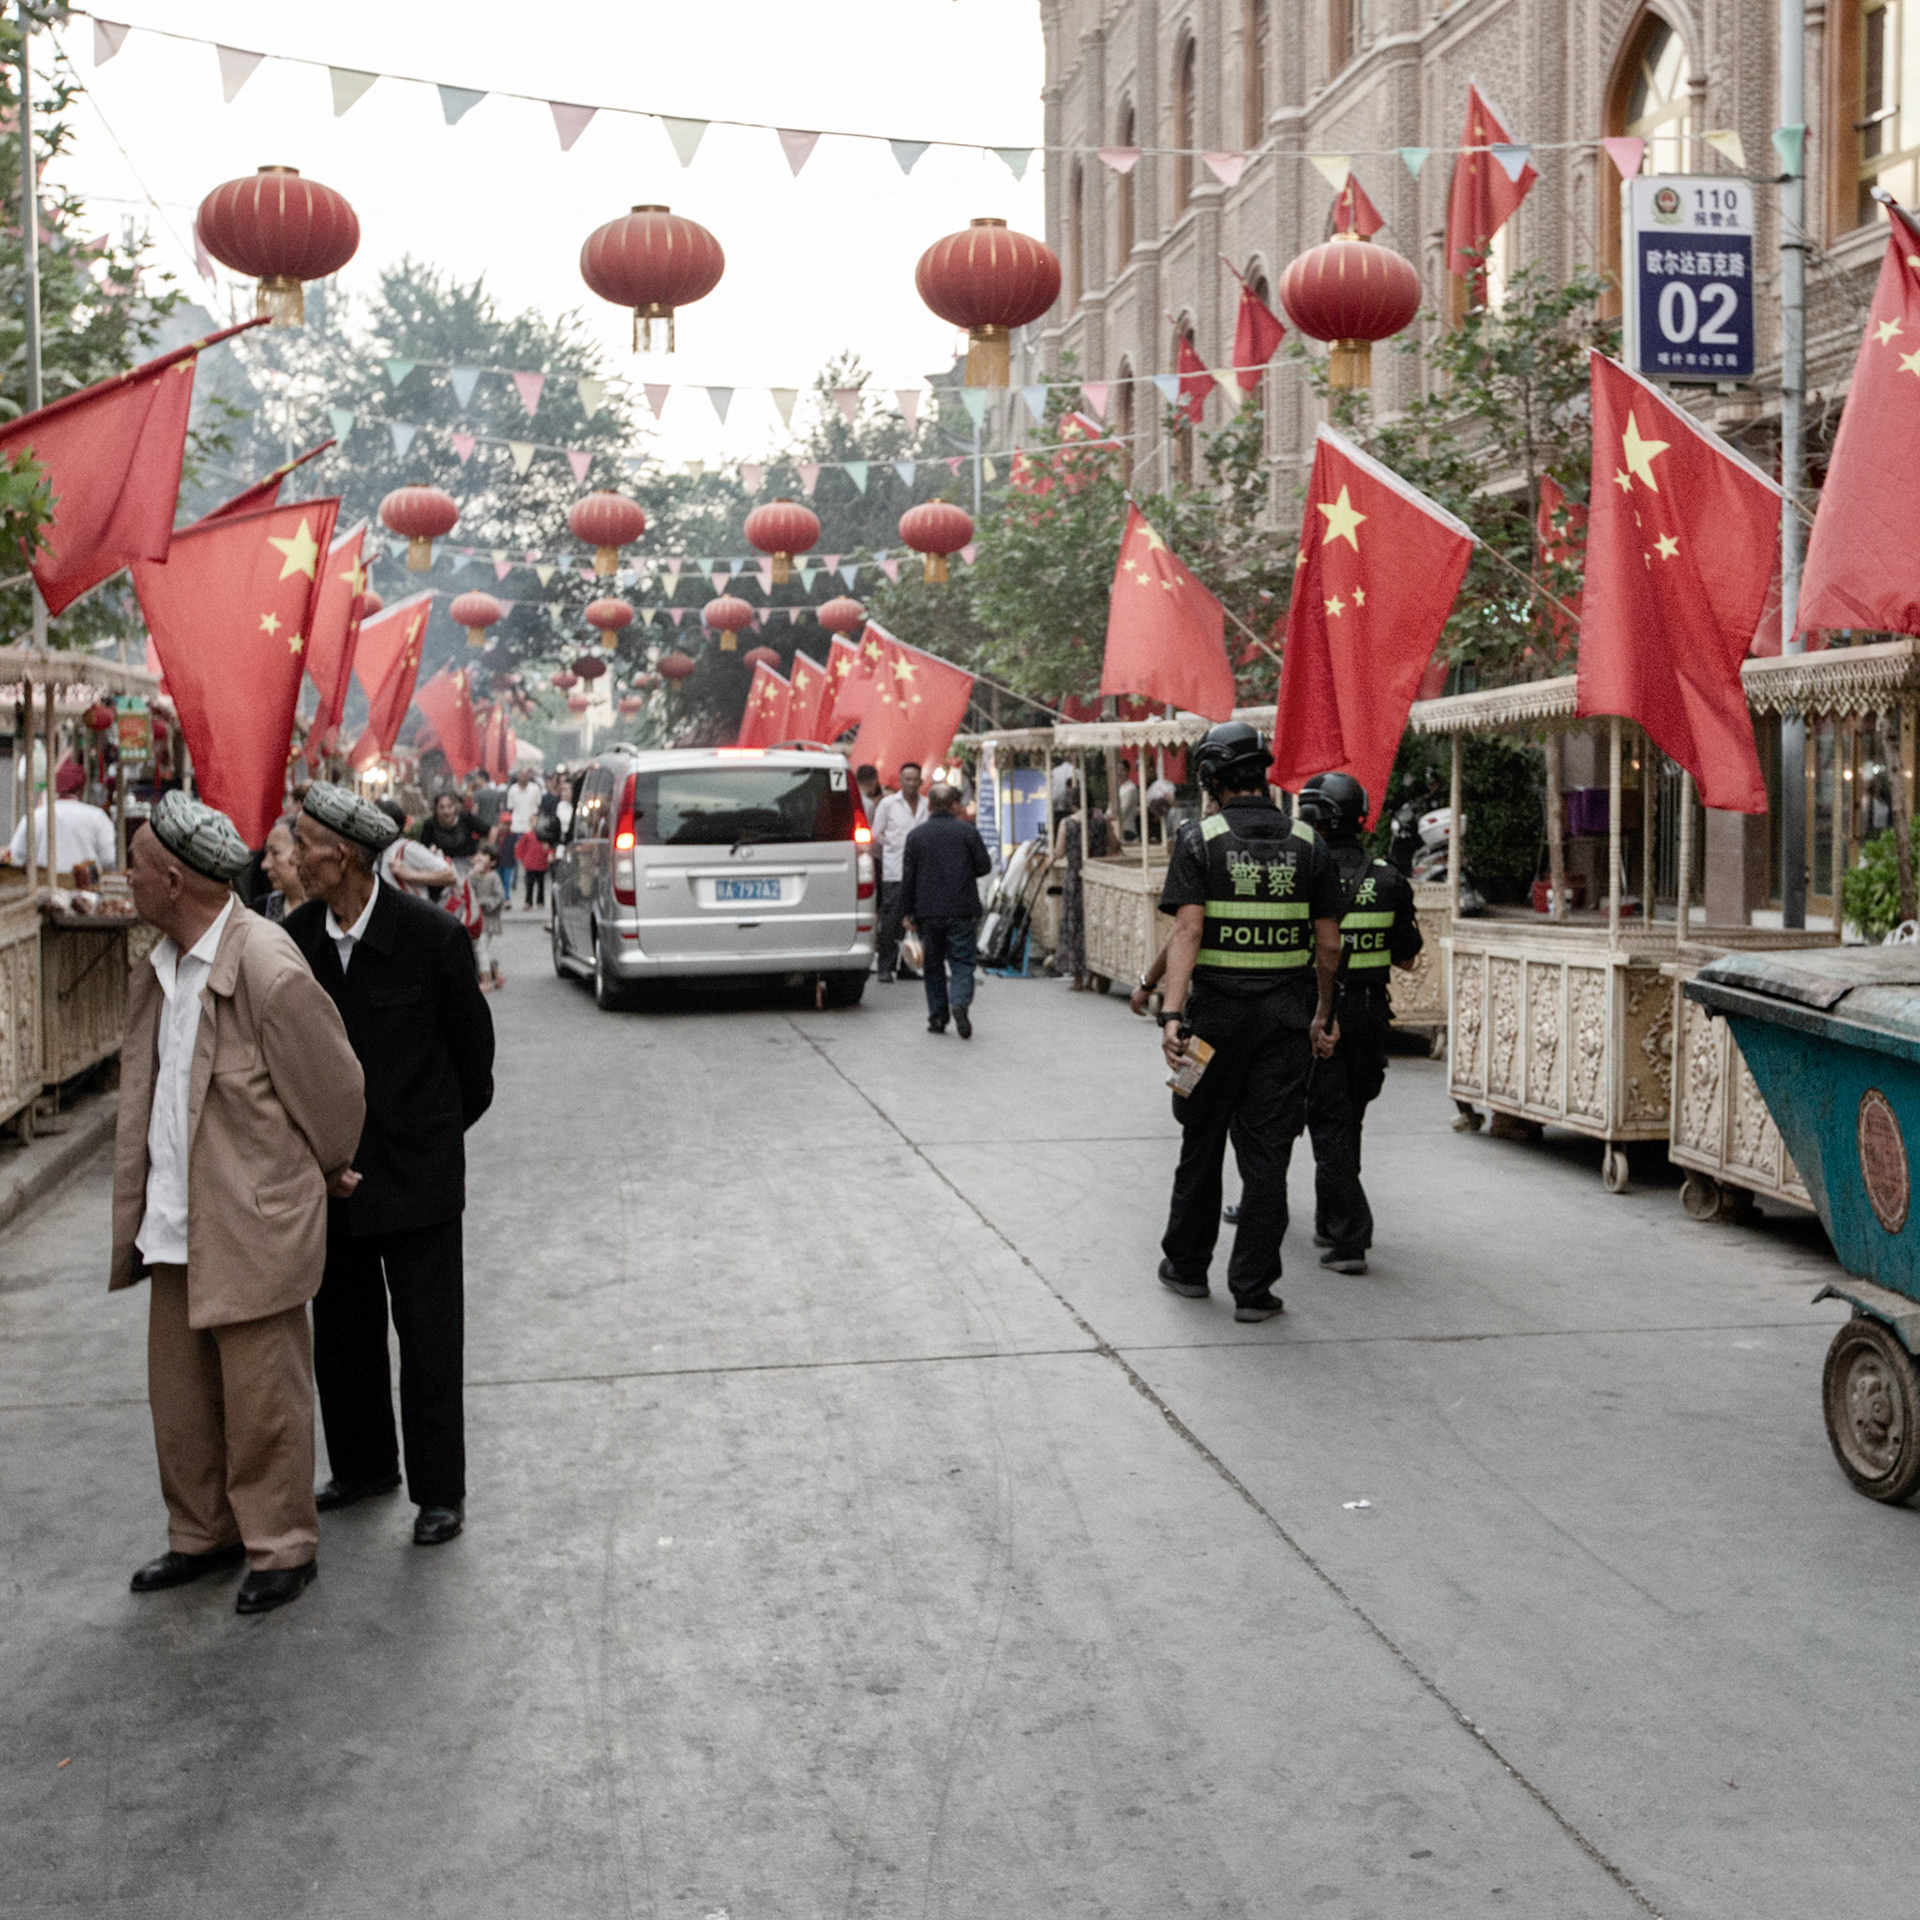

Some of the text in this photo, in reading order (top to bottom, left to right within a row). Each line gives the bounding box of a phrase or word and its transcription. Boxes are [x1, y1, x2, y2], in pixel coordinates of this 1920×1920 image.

[1694, 189, 1738, 210] 110
[1694, 212, 1739, 227] 报警点
[1646, 250, 1745, 277] 欧尔达西克路
[1658, 281, 1739, 345] 02
[832, 771, 843, 786] 7
[1229, 862, 1297, 897] 警察
[1219, 926, 1300, 946] POLICE
